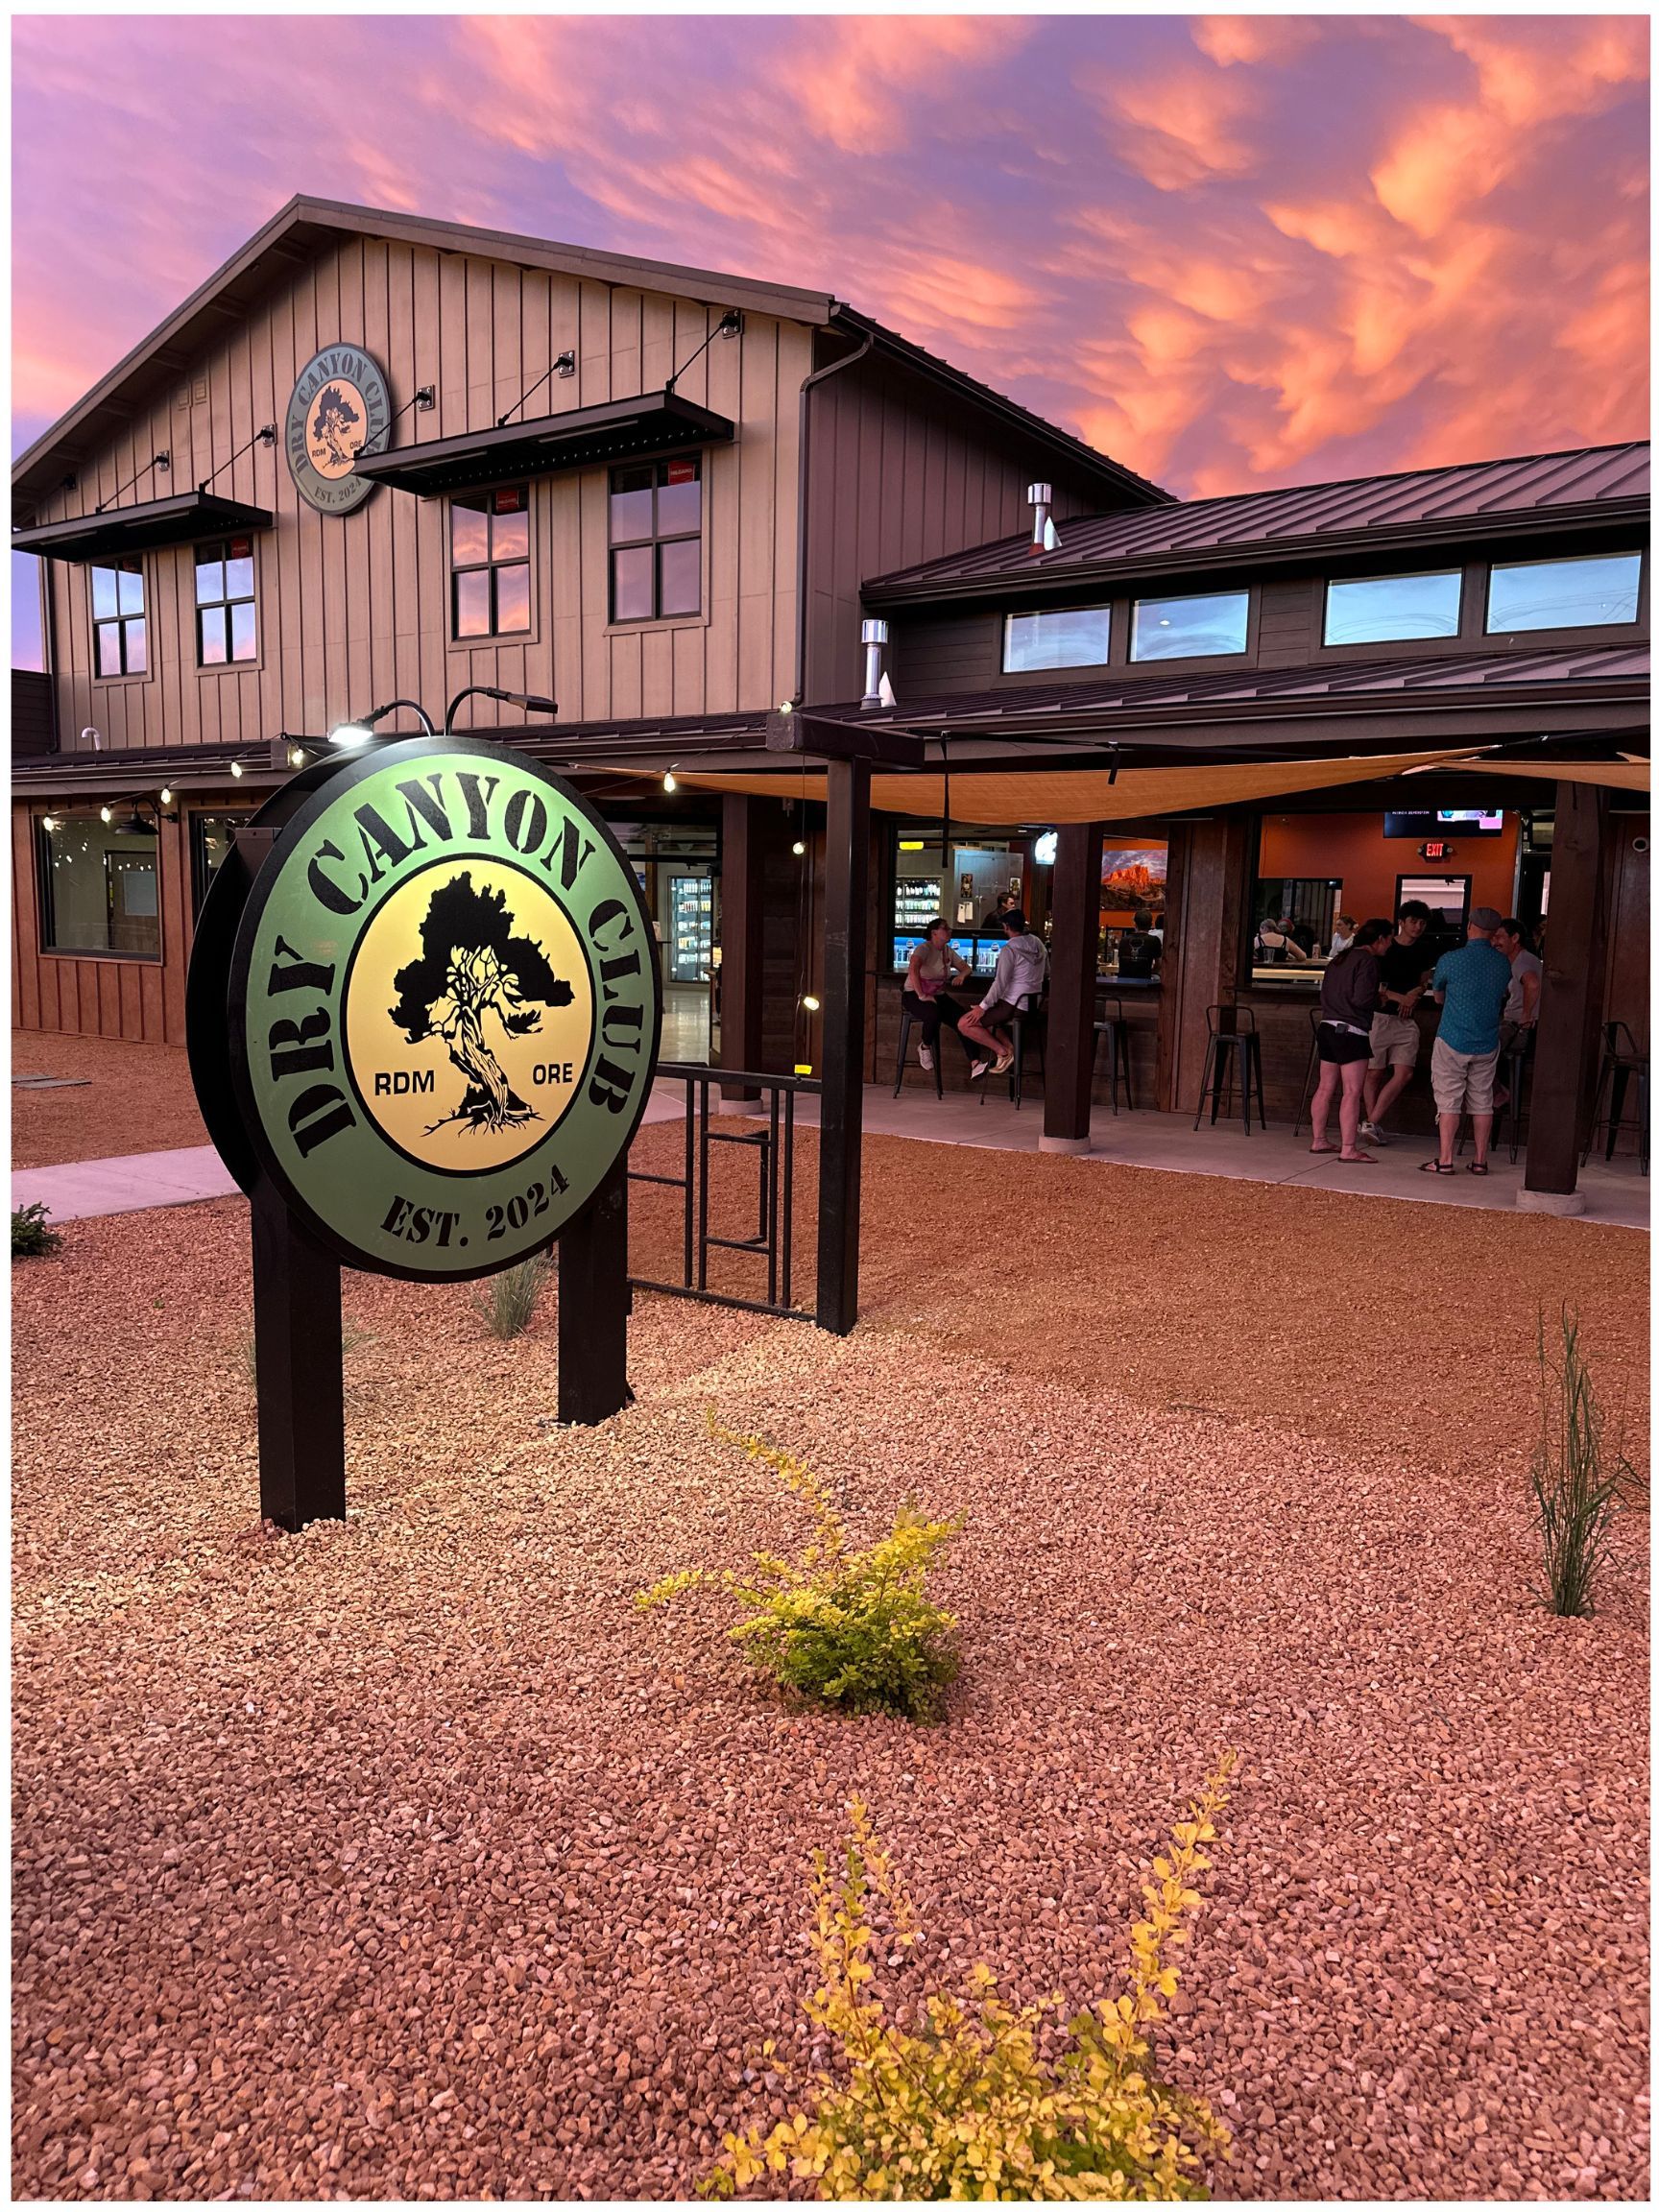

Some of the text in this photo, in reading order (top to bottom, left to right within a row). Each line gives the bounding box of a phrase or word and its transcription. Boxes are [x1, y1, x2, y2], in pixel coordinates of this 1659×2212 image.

[298, 352, 368, 406] CANYON
[291, 415, 308, 474] DRY
[311, 447, 326, 458] RDM
[349, 441, 362, 449] ORE
[314, 476, 362, 504] EST. 2024
[1426, 843, 1444, 857] EXIT
[267, 772, 644, 1160] DRY CANYON CLUB
[374, 1070, 435, 1096] RDM
[533, 1062, 573, 1085] ORE
[380, 1164, 569, 1248] EST. 2024
